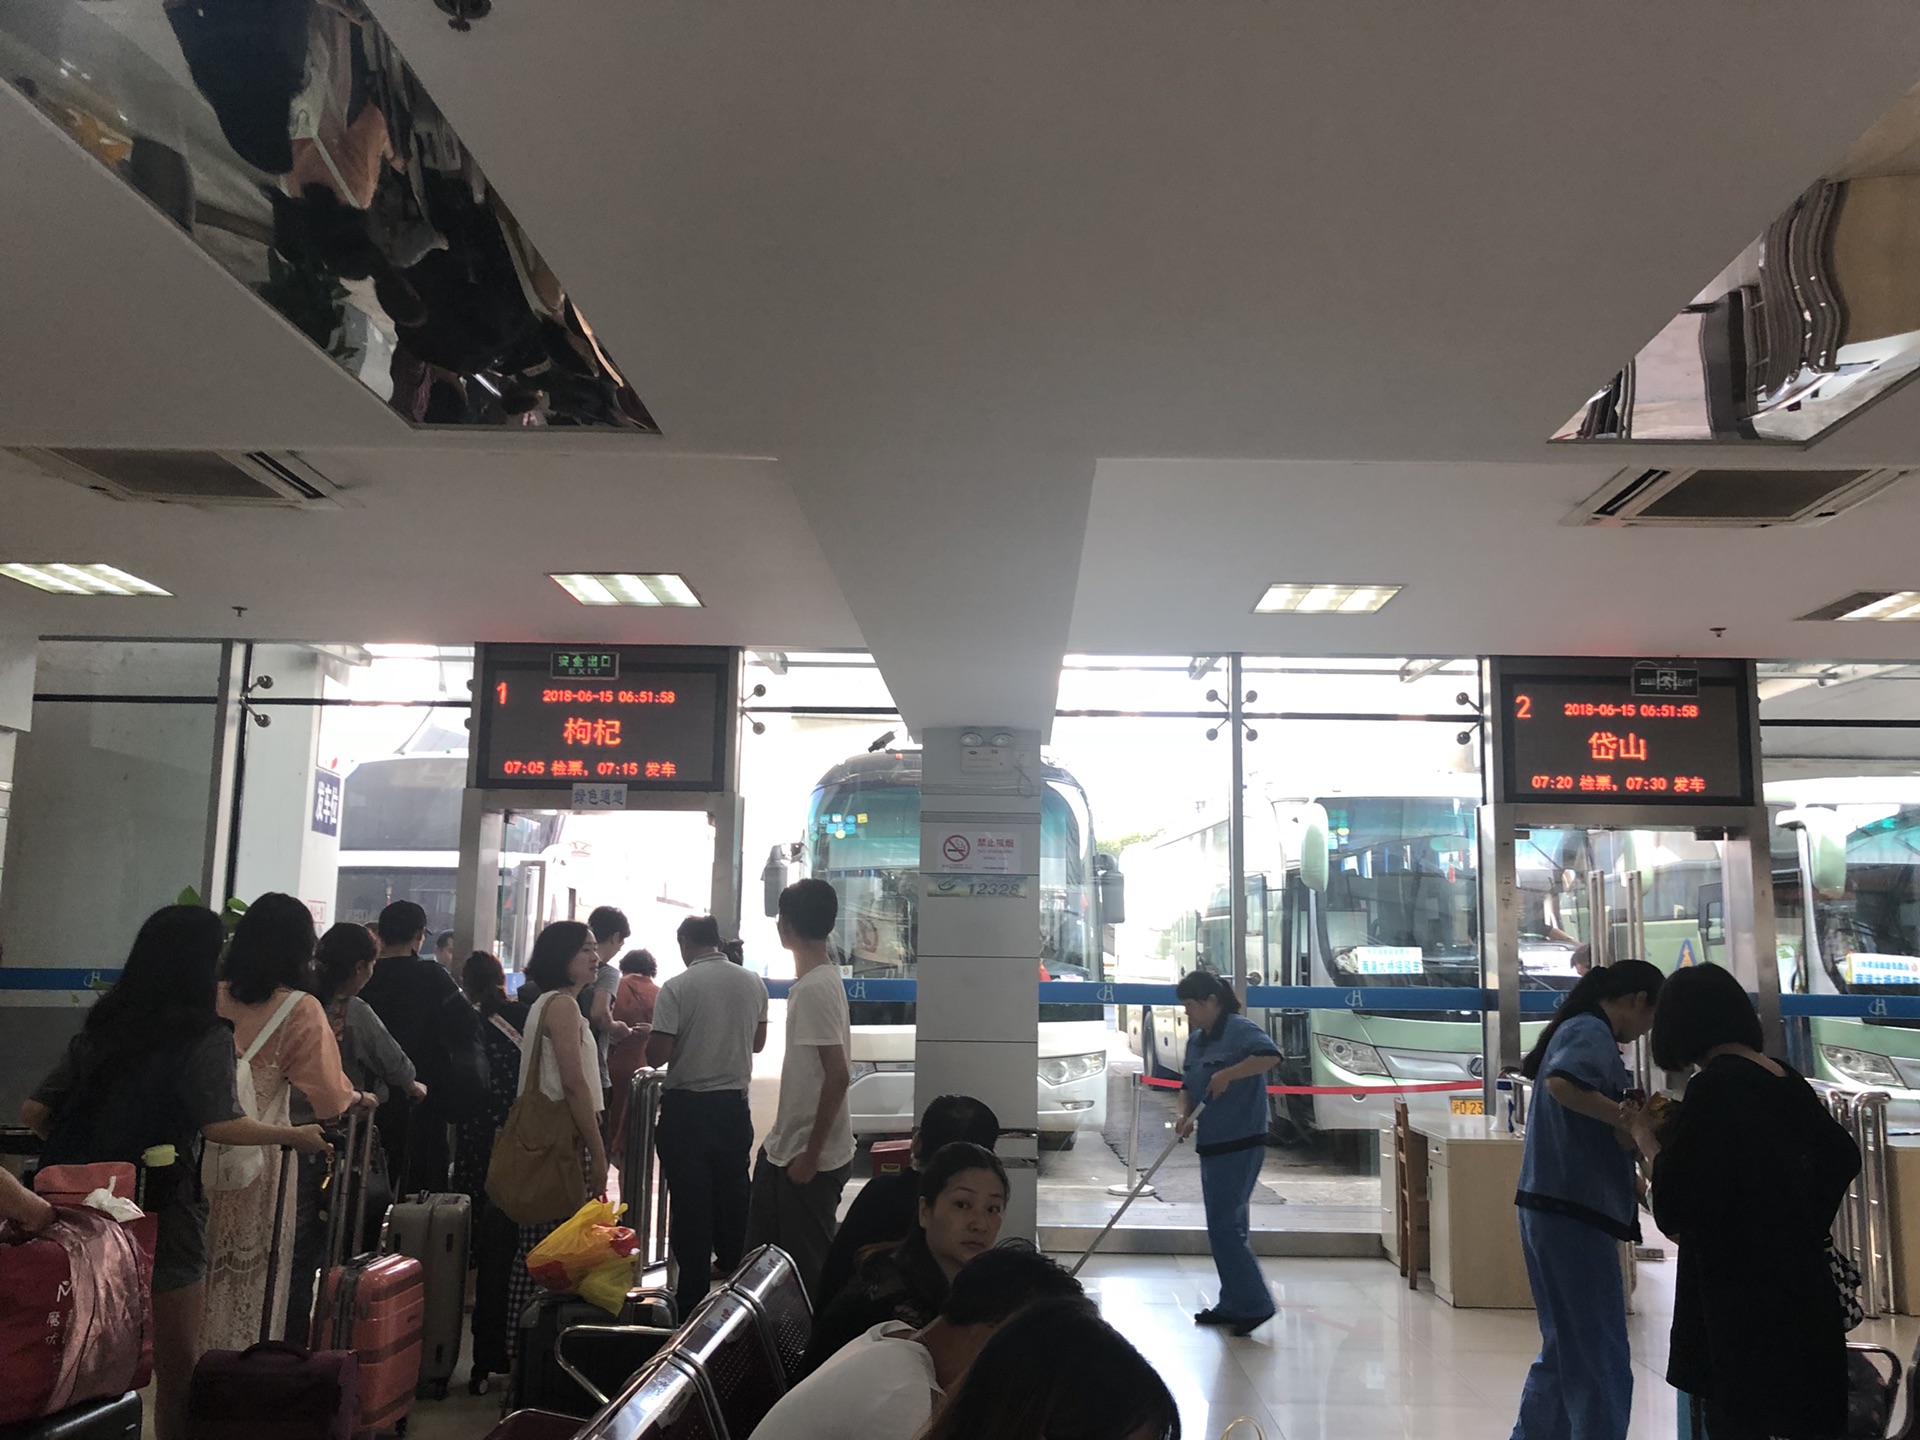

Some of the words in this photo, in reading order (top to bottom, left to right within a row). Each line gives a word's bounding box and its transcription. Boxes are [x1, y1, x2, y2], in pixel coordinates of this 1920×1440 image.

[558, 655, 611, 668] 安全出口
[496, 681, 508, 705] 1
[542, 689, 614, 703] 2018-06-15
[618, 690, 676, 704] 06:51:58
[1515, 694, 1532, 718] 2
[1564, 703, 1636, 717] 2018-06-15
[1640, 704, 1699, 718] 06:51:58
[563, 717, 622, 746] 枸杞
[1588, 731, 1648, 761] 岱山
[504, 760, 545, 775] 07:05
[597, 761, 638, 775] 07:15
[645, 761, 677, 778] 发车
[1531, 775, 1573, 789] 07:20
[1626, 776, 1667, 791] 07:30
[1673, 776, 1706, 793] 发车
[573, 787, 624, 806] 绿色通道
[967, 882, 1020, 896] 12328
